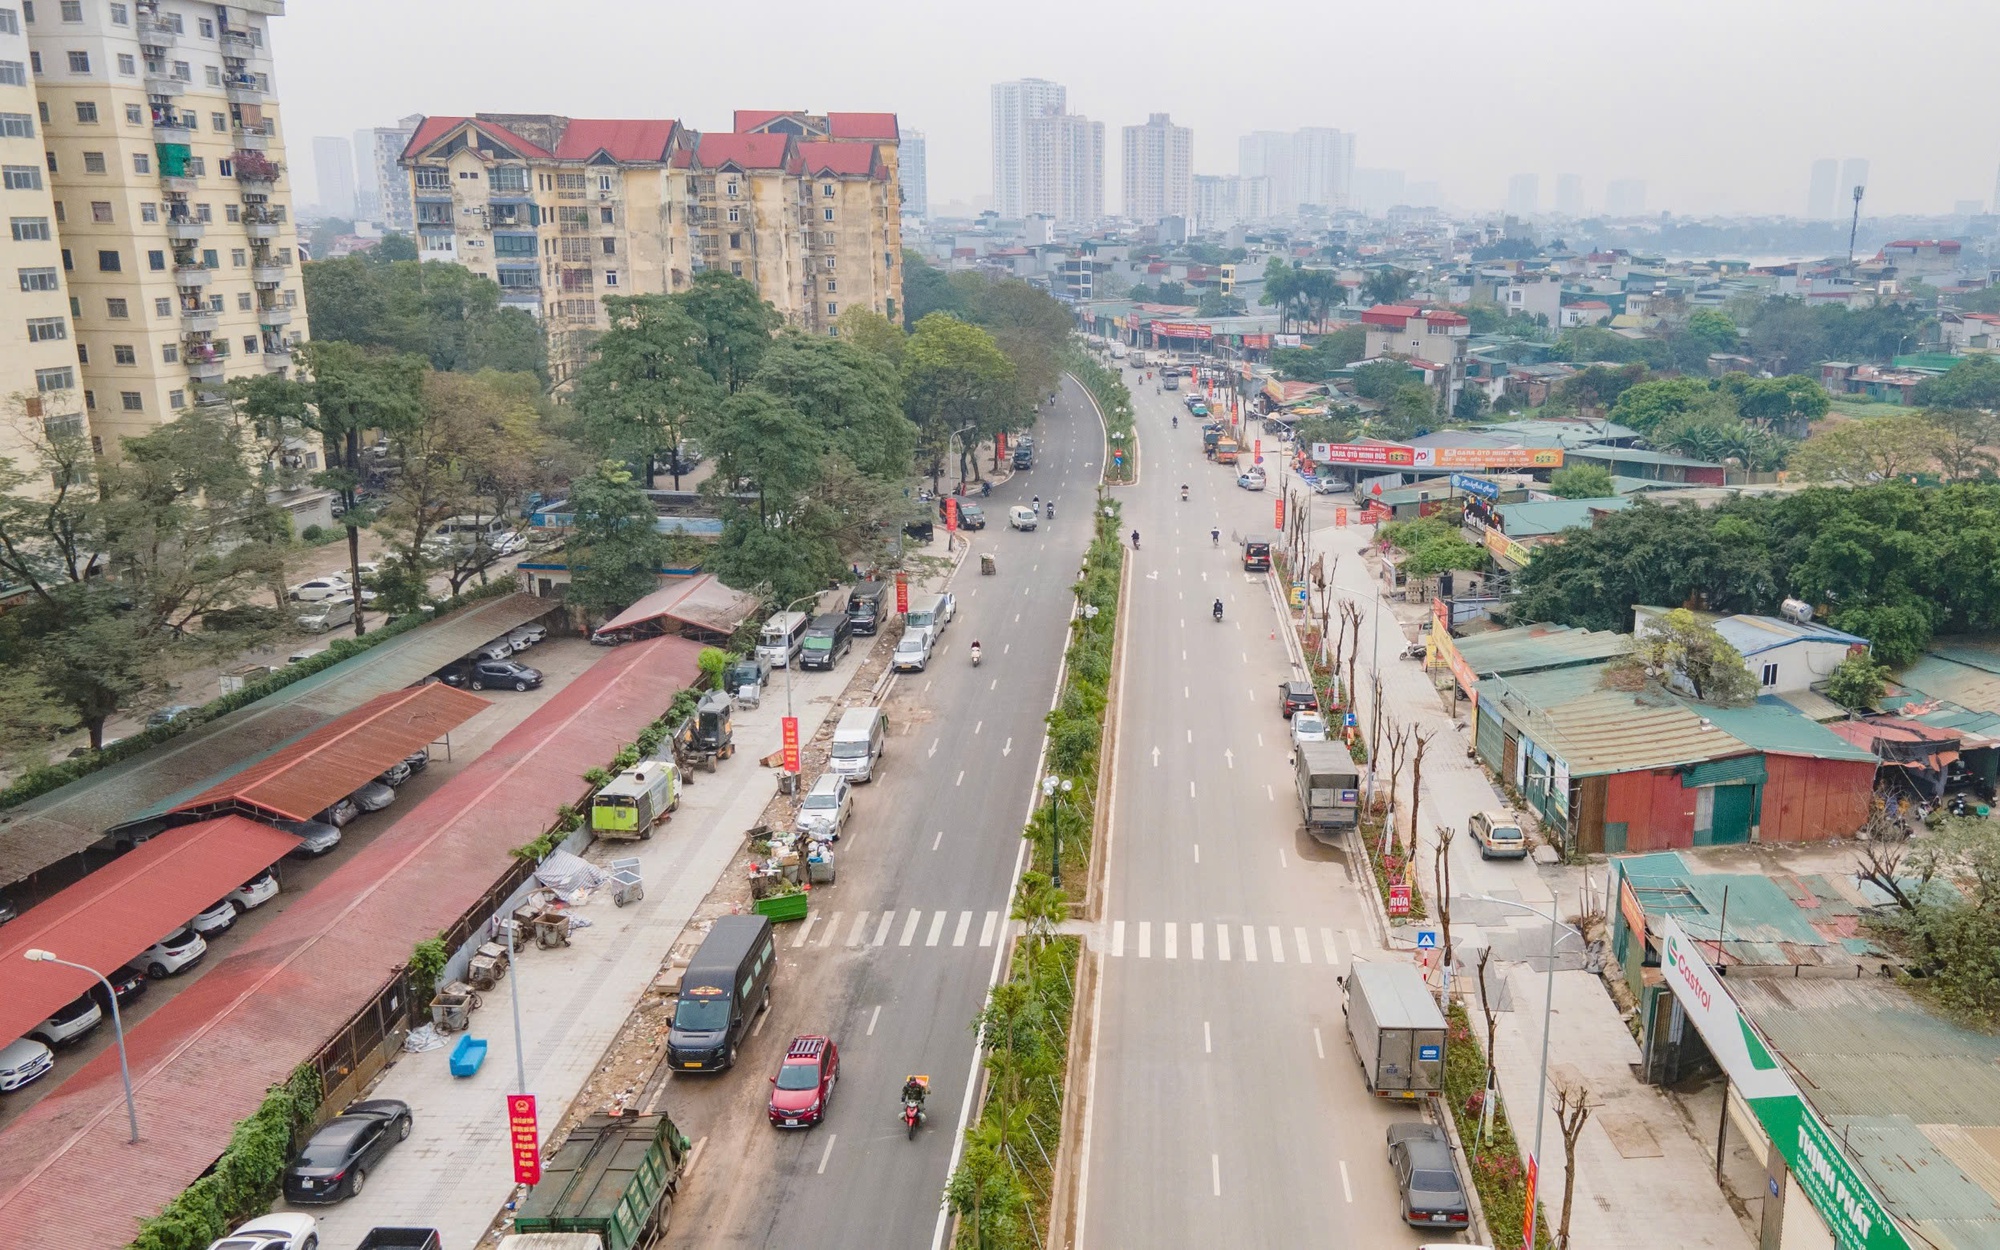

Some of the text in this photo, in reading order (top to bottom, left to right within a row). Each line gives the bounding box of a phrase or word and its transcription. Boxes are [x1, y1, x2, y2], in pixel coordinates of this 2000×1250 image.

[1391, 894, 1409, 907] RỬA
[1678, 954, 1711, 1012] Castrol
[1797, 1124, 1872, 1240] THỊNH PHÁT
